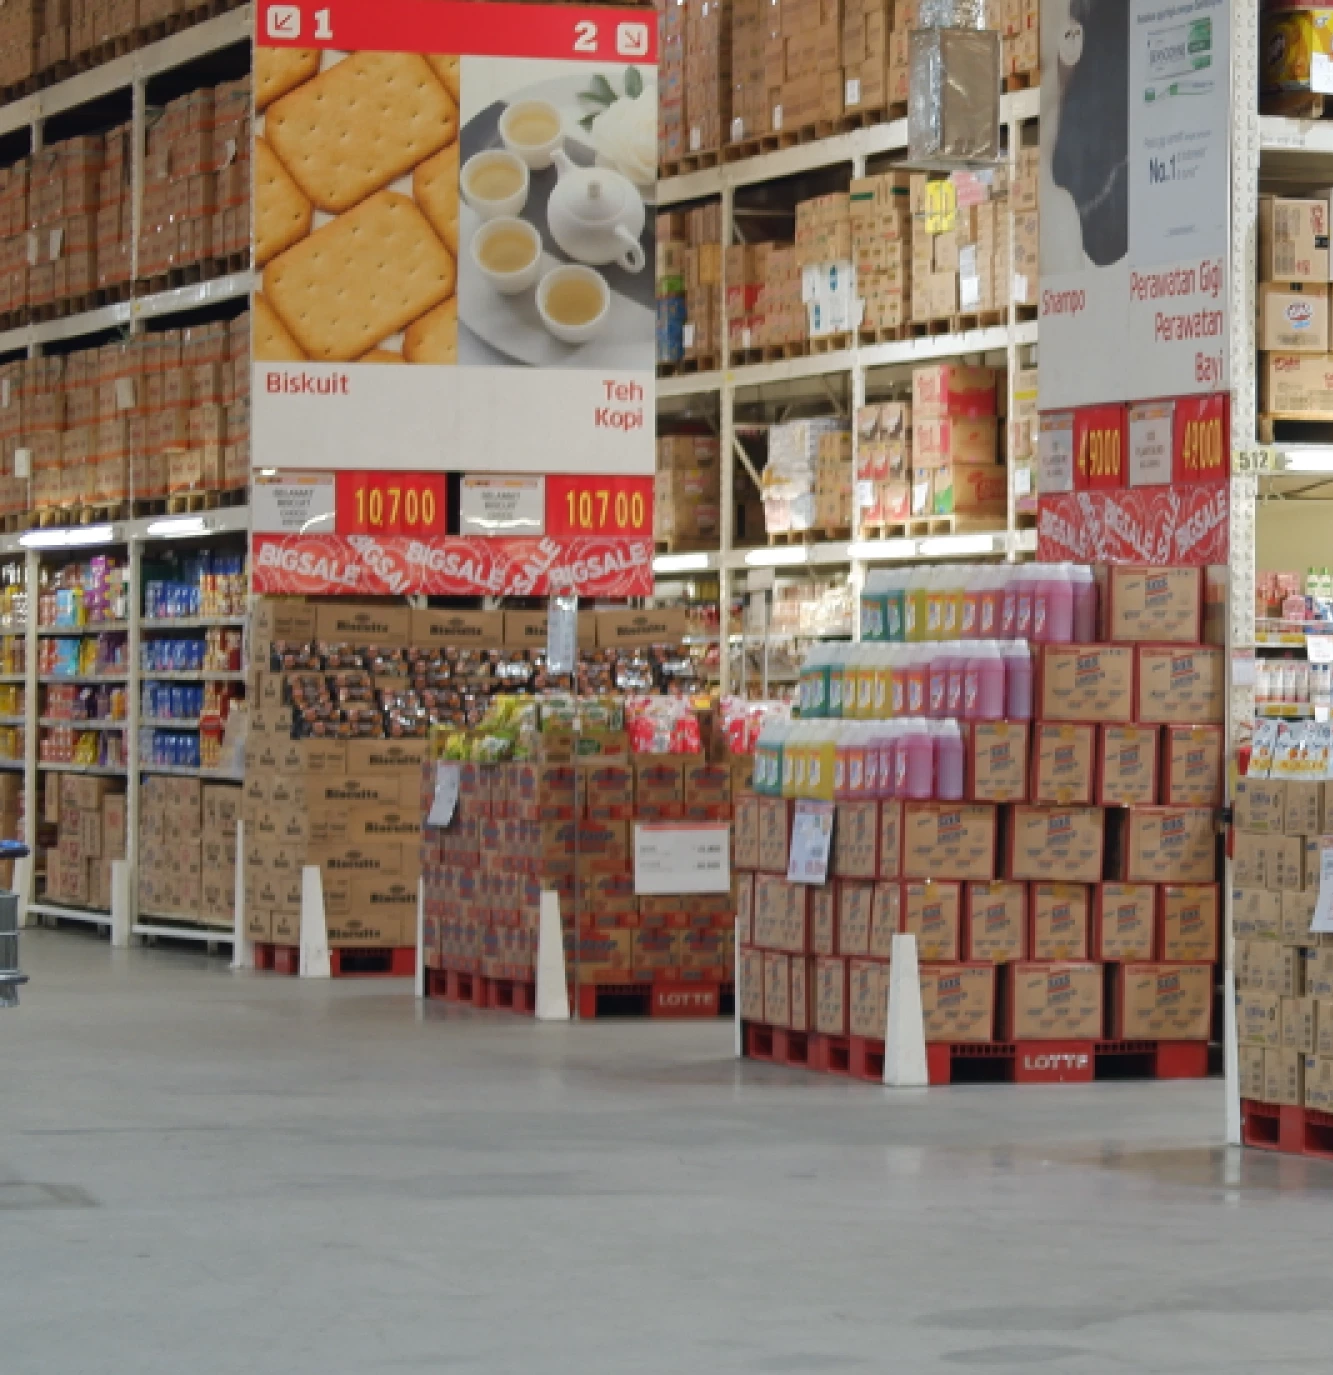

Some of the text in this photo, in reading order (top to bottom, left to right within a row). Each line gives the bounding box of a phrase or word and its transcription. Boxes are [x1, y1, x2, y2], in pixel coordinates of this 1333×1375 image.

[315, 8, 333, 39] 1
[573, 20, 598, 51] 2
[1130, 257, 1223, 302] Perawatan Gigi
[1042, 289, 1085, 317] Shampo
[1155, 306, 1223, 342] Perawatan
[266, 372, 349, 394] Biskuit
[1195, 349, 1223, 388] Bayi
[603, 380, 643, 400] Teh
[594, 408, 643, 430] Kopi
